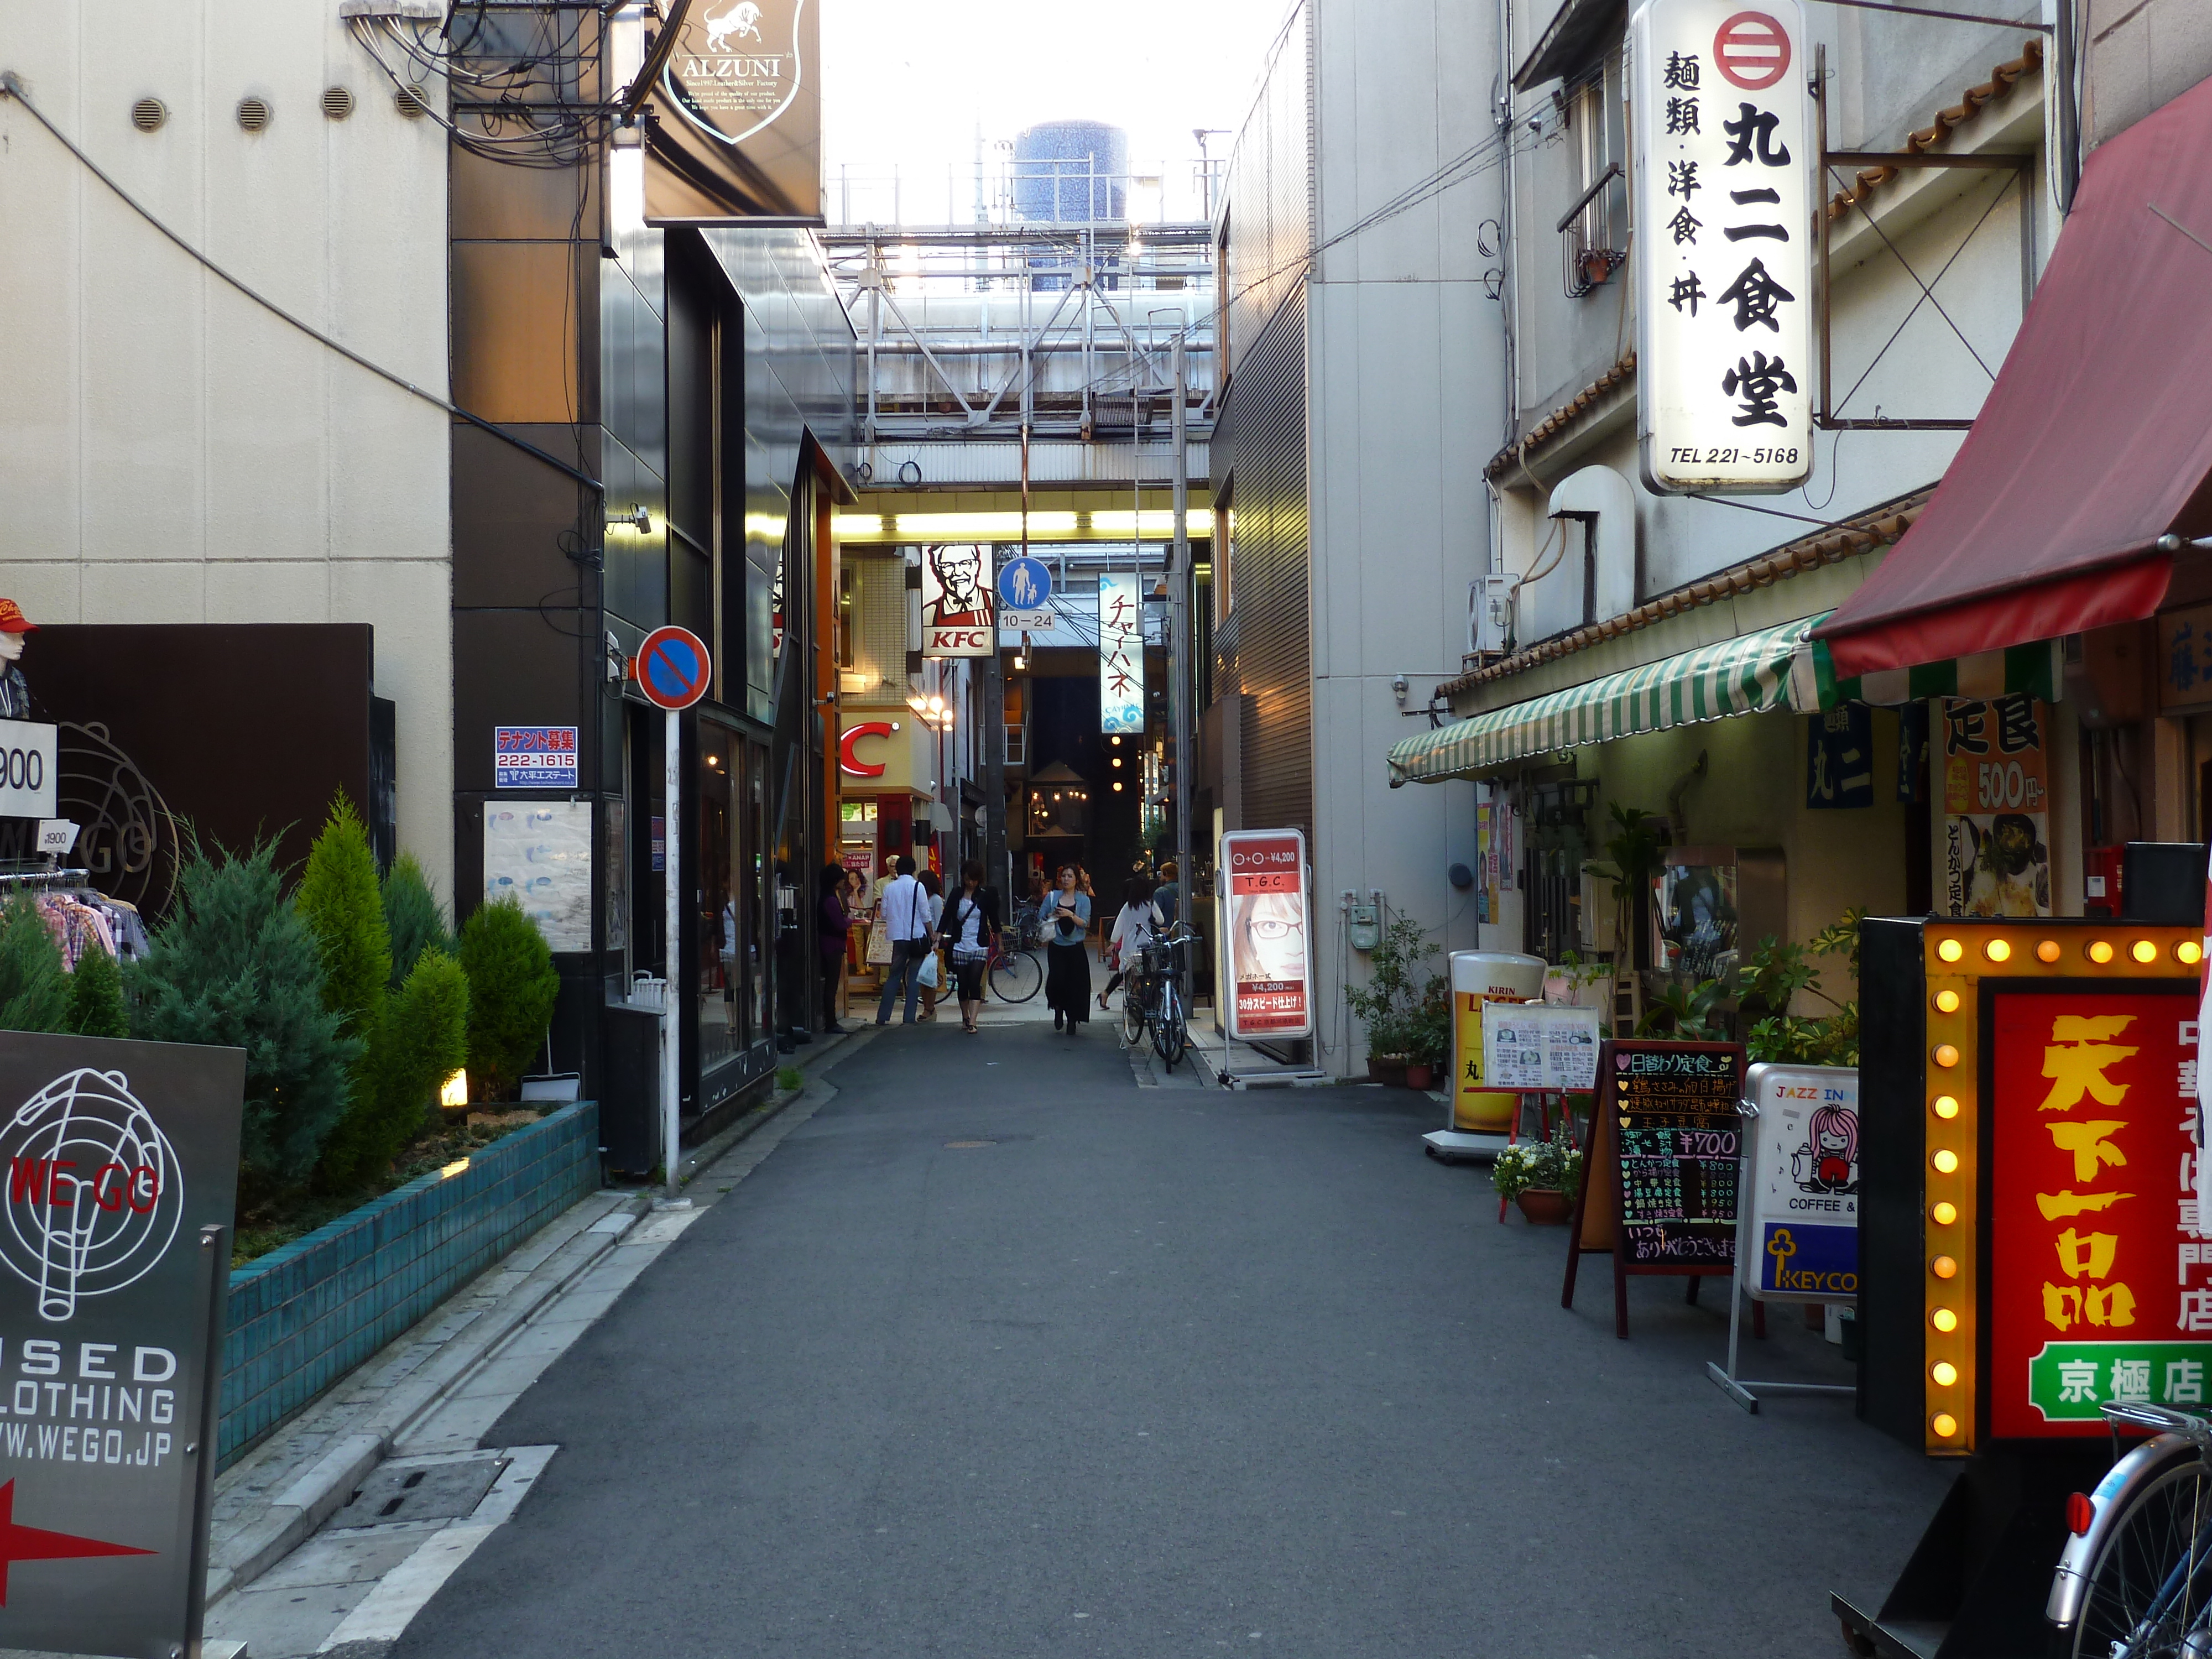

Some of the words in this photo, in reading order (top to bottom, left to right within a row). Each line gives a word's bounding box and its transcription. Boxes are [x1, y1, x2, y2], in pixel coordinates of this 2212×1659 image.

[682, 59, 780, 77] ALZUNI
[1717, 102, 1797, 427] 丸二食堂
[1671, 447, 1702, 463] TEL
[931, 632, 986, 648] KFC
[499, 730, 574, 750] テナント募集
[499, 755, 575, 766] 222-1615
[1488, 985, 1516, 995] KIRIN
[1776, 1086, 1818, 1100] JAZZ
[1679, 1131, 1736, 1155] ¥700
[1631, 1159, 1680, 1169] とんかつ定食
[1699, 1160, 1733, 1171] ¥800
[2036, 1015, 2140, 1332] 天下一品
[12, 1157, 76, 1207] WE
[93, 1162, 159, 1214] GO
[1700, 1179, 1733, 1188] ¥800
[1700, 1189, 1733, 1198] ¥800
[1701, 1198, 1733, 1208] ¥950
[1789, 1198, 1841, 1212] COFFEE
[1846, 1204, 1855, 1212] &
[1702, 1210, 1734, 1218] ¥950
[0, 1337, 178, 1382] SED
[2057, 1358, 2204, 1404] 京極店
